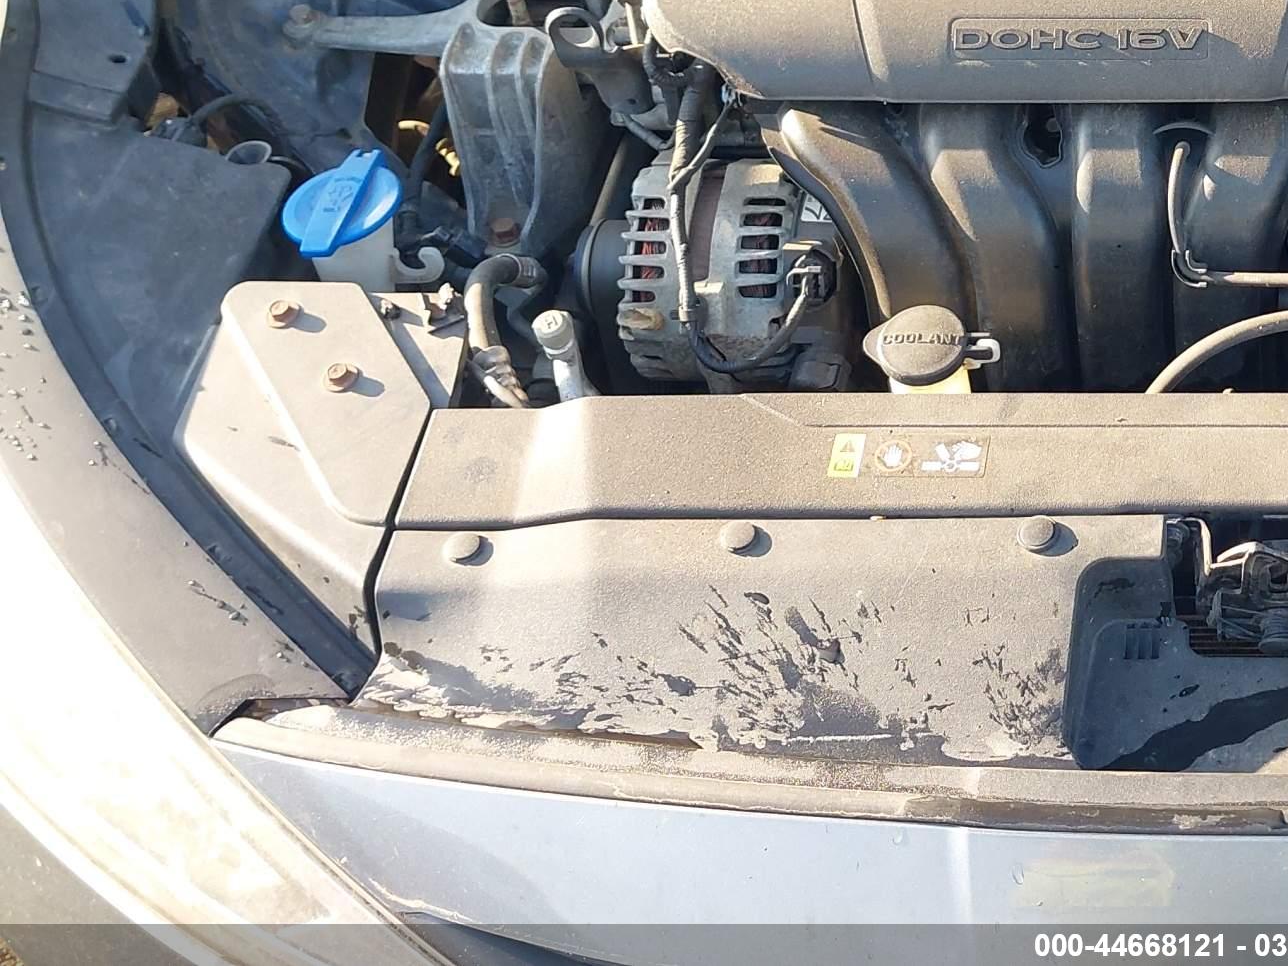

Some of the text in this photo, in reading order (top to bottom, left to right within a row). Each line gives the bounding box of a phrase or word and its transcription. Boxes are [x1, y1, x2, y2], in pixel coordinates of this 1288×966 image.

[953, 28, 1205, 50] DOHC 16V
[883, 332, 962, 346] COOLANT
